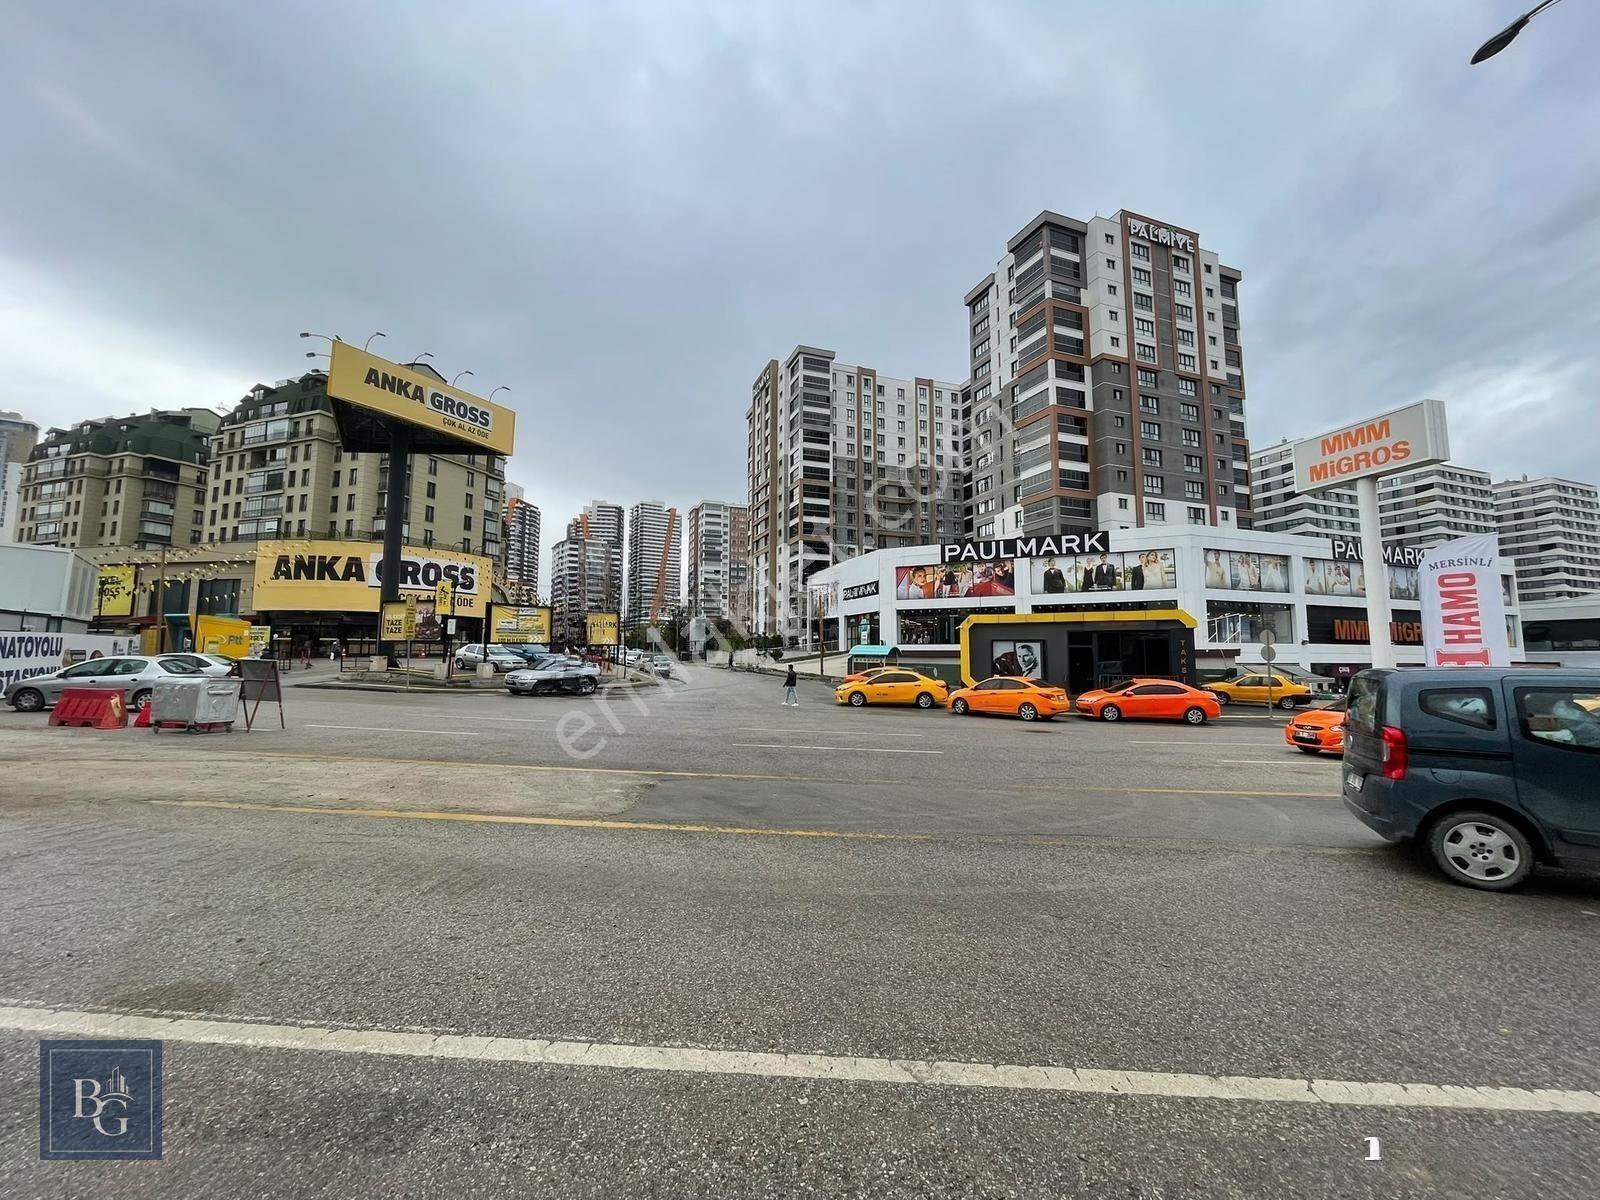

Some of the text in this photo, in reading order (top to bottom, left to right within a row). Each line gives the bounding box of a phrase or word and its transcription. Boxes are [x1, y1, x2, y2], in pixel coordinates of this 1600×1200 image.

[364, 367, 490, 427] ANKA GROSS
[458, 423, 466, 431] AL
[467, 426, 476, 435] AZ
[1321, 419, 1391, 456] MMM
[945, 532, 1106, 563] PAULMARK
[1334, 541, 1425, 566] PAUMARK
[272, 555, 366, 582] ANKA
[457, 595, 474, 607] ÖDE
[1437, 571, 1483, 645] HAMO
